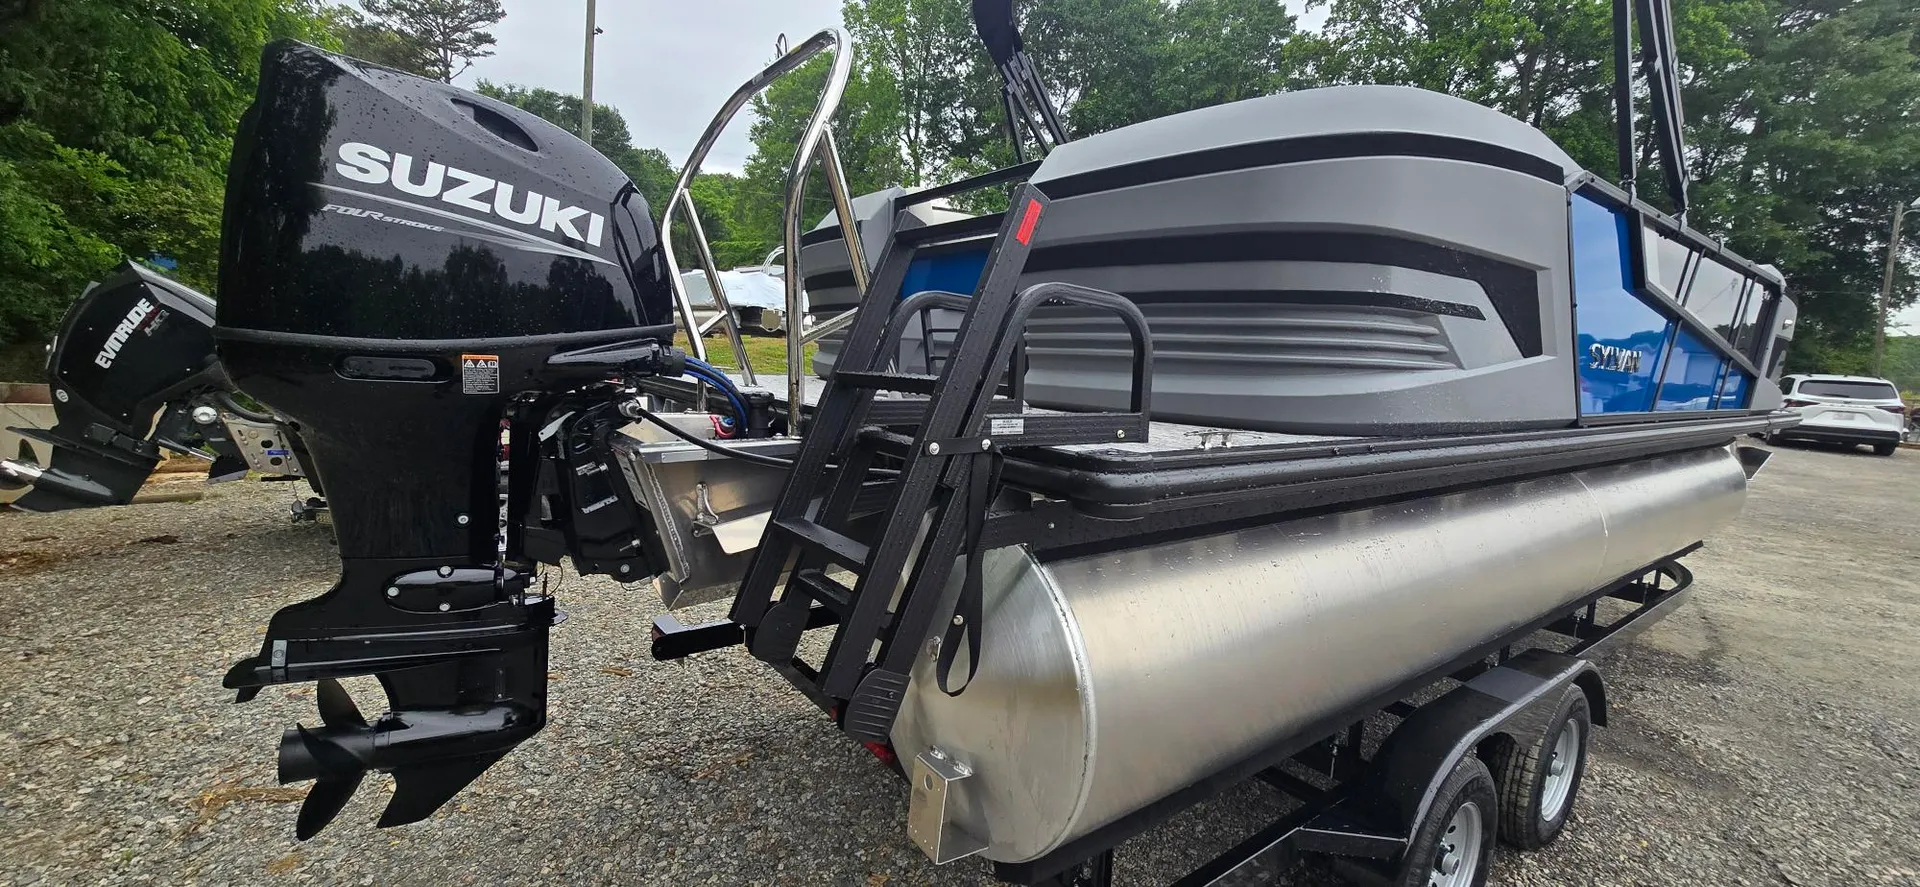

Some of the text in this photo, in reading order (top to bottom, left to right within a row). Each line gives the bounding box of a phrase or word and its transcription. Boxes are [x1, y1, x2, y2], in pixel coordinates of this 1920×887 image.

[321, 203, 445, 232] FOUR STROKE
[335, 142, 604, 248] SUZUKI
[94, 297, 155, 369] EVINRUDE
[1589, 343, 1642, 373] SYLVAN
